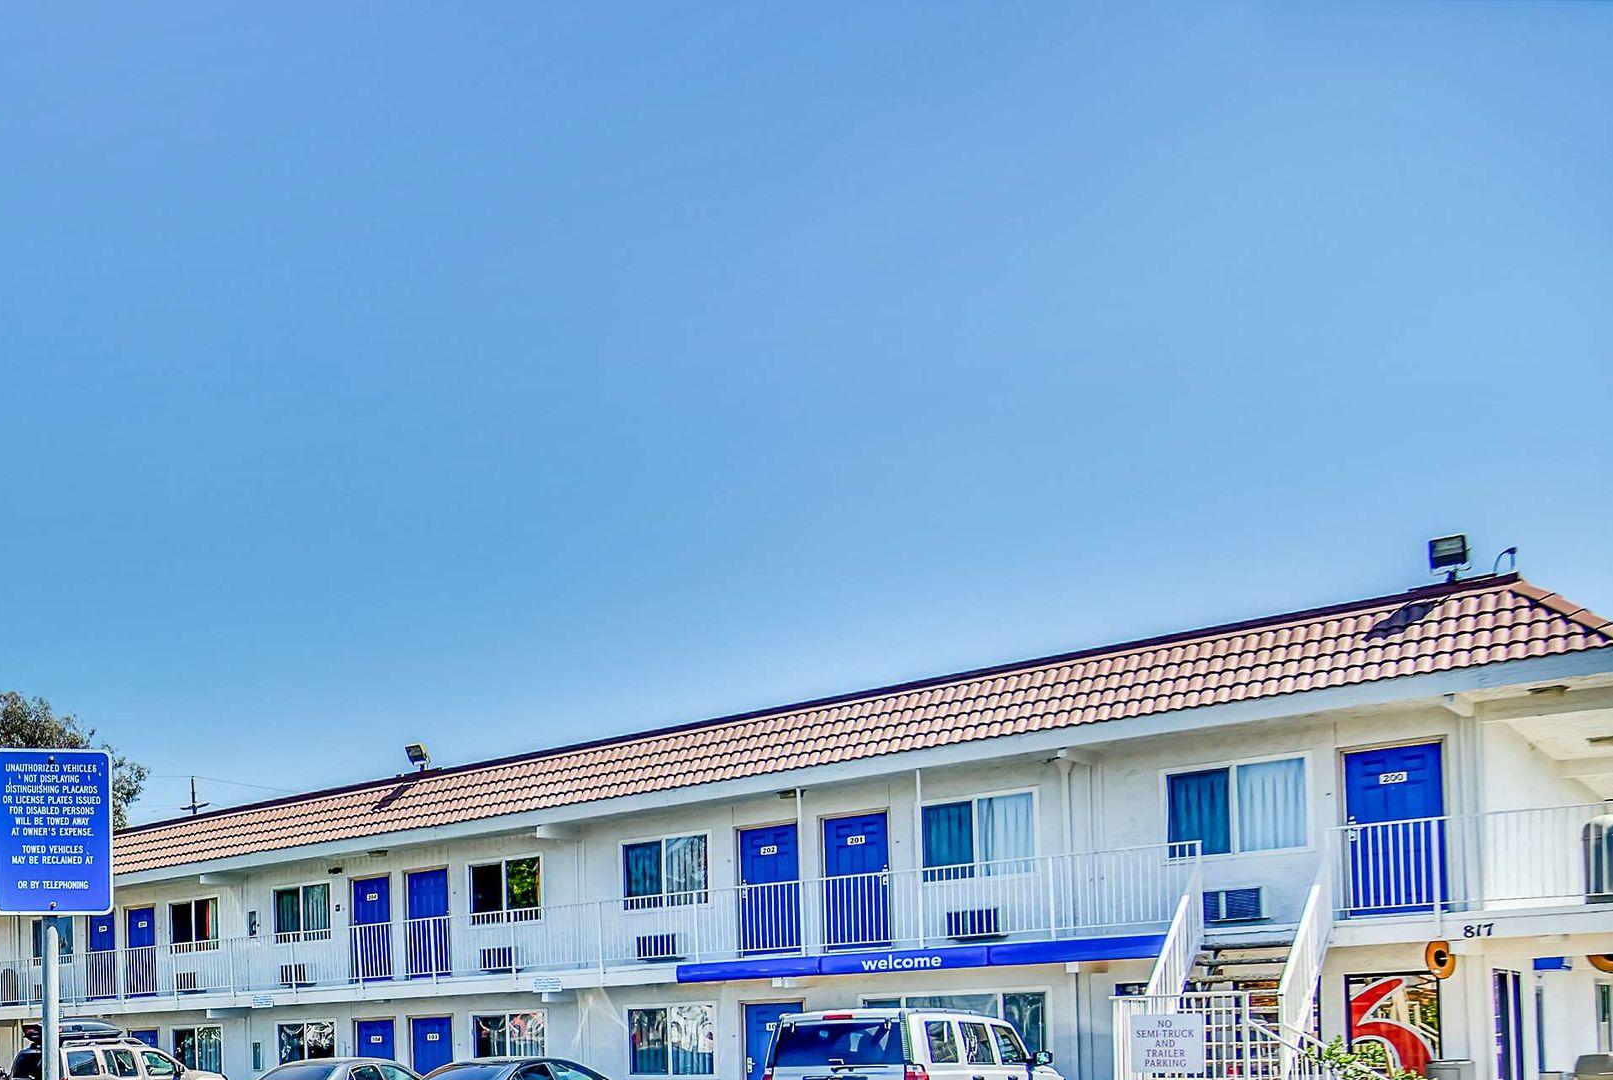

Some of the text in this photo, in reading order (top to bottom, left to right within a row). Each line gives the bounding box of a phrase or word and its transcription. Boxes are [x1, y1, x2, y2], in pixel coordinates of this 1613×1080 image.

[5, 763, 97, 773] UNAUTHORIZED VEHICLES
[23, 774, 80, 783] NOT DISPLAYING
[1382, 773, 1404, 783] 200
[5, 784, 98, 794] DISTINGUISHING PLACARDS
[2, 795, 101, 805] OR LICENSE PLATES ISSUED
[9, 806, 95, 815] FOR DISABLED PERSONS
[14, 817, 90, 826] WILL BE TOWED AWAY
[10, 827, 94, 837] AT OWNER'S EXPENSE.
[849, 836, 864, 844] 201
[22, 844, 84, 854] TOWED VEHICLES
[11, 855, 94, 865] MAY BE RECLAIMED AT
[17, 880, 89, 890] OR BY TELEPHONING
[1463, 922, 1495, 939] 817
[861, 954, 942, 971] welcome
[1157, 1019, 1173, 1028] NO
[1135, 1029, 1195, 1038] SEMI-TRUCK
[1155, 1039, 1176, 1048] AND
[1145, 1049, 1186, 1058] TRAILER
[1144, 1058, 1187, 1067] PARKING
